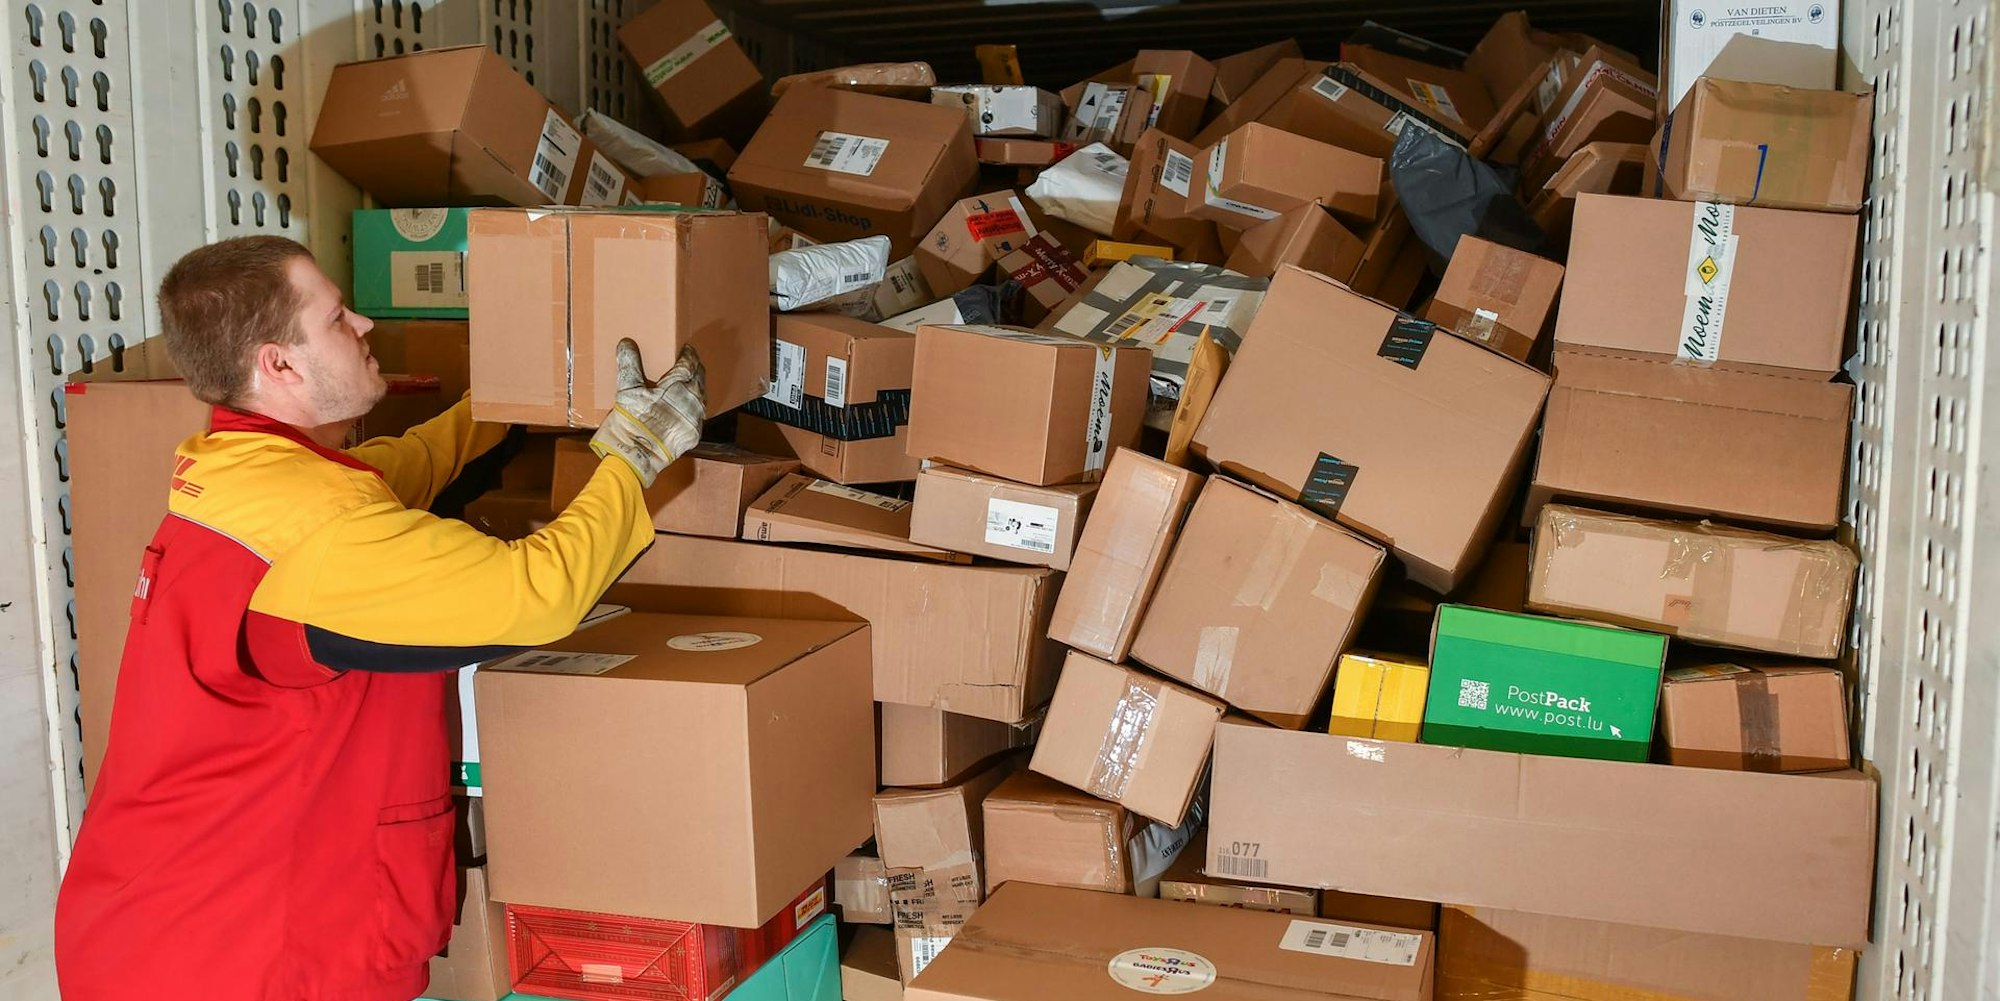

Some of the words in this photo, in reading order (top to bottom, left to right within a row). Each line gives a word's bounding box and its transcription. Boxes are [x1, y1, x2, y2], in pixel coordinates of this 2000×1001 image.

[1727, 8, 1750, 17] VAN
[1751, 6, 1788, 16] DIETEN
[1035, 248, 1058, 271] Merry
[1507, 685, 1592, 713] PostPack
[1494, 703, 1603, 731] www.post.lu
[1232, 841, 1260, 858] 077
[888, 873, 915, 884] FRESH
[897, 911, 924, 920] FRESH
